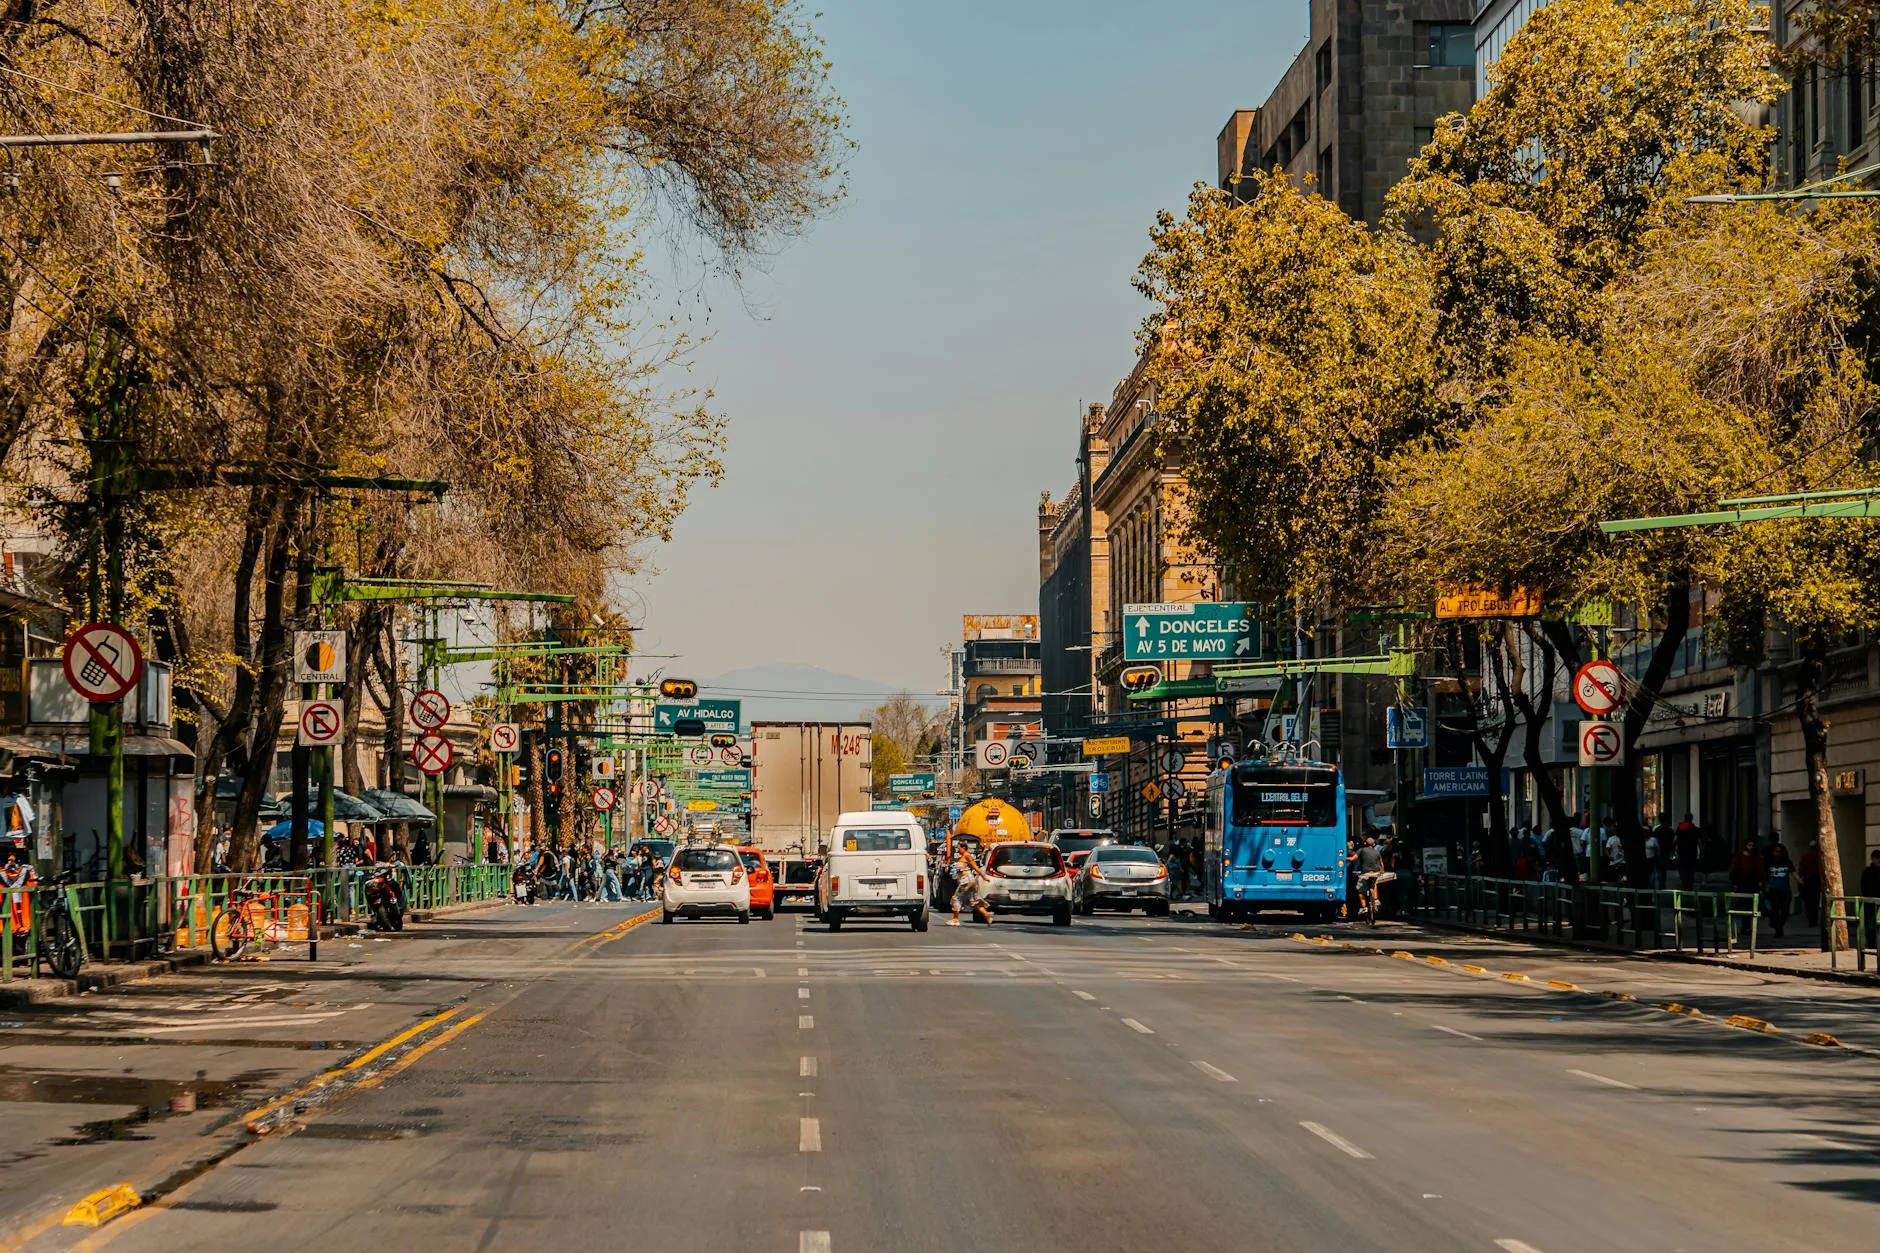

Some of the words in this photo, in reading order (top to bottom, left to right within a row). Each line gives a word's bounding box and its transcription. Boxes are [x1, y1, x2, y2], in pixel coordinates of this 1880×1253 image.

[1440, 601, 1453, 613] AL
[1457, 599, 1510, 612] TROLEBUS
[1160, 620, 1250, 634] DONCELES
[1137, 640, 1153, 653] AV
[1158, 640, 1166, 653] 5
[1172, 640, 1187, 653] DE
[1193, 639, 1226, 653] MAYO
[677, 709, 690, 718] AV
[694, 710, 734, 719] HIDALGO
[1429, 772, 1456, 781] TORRE
[1432, 782, 1486, 792] AMERICANA
[1302, 874, 1330, 882] 22024
